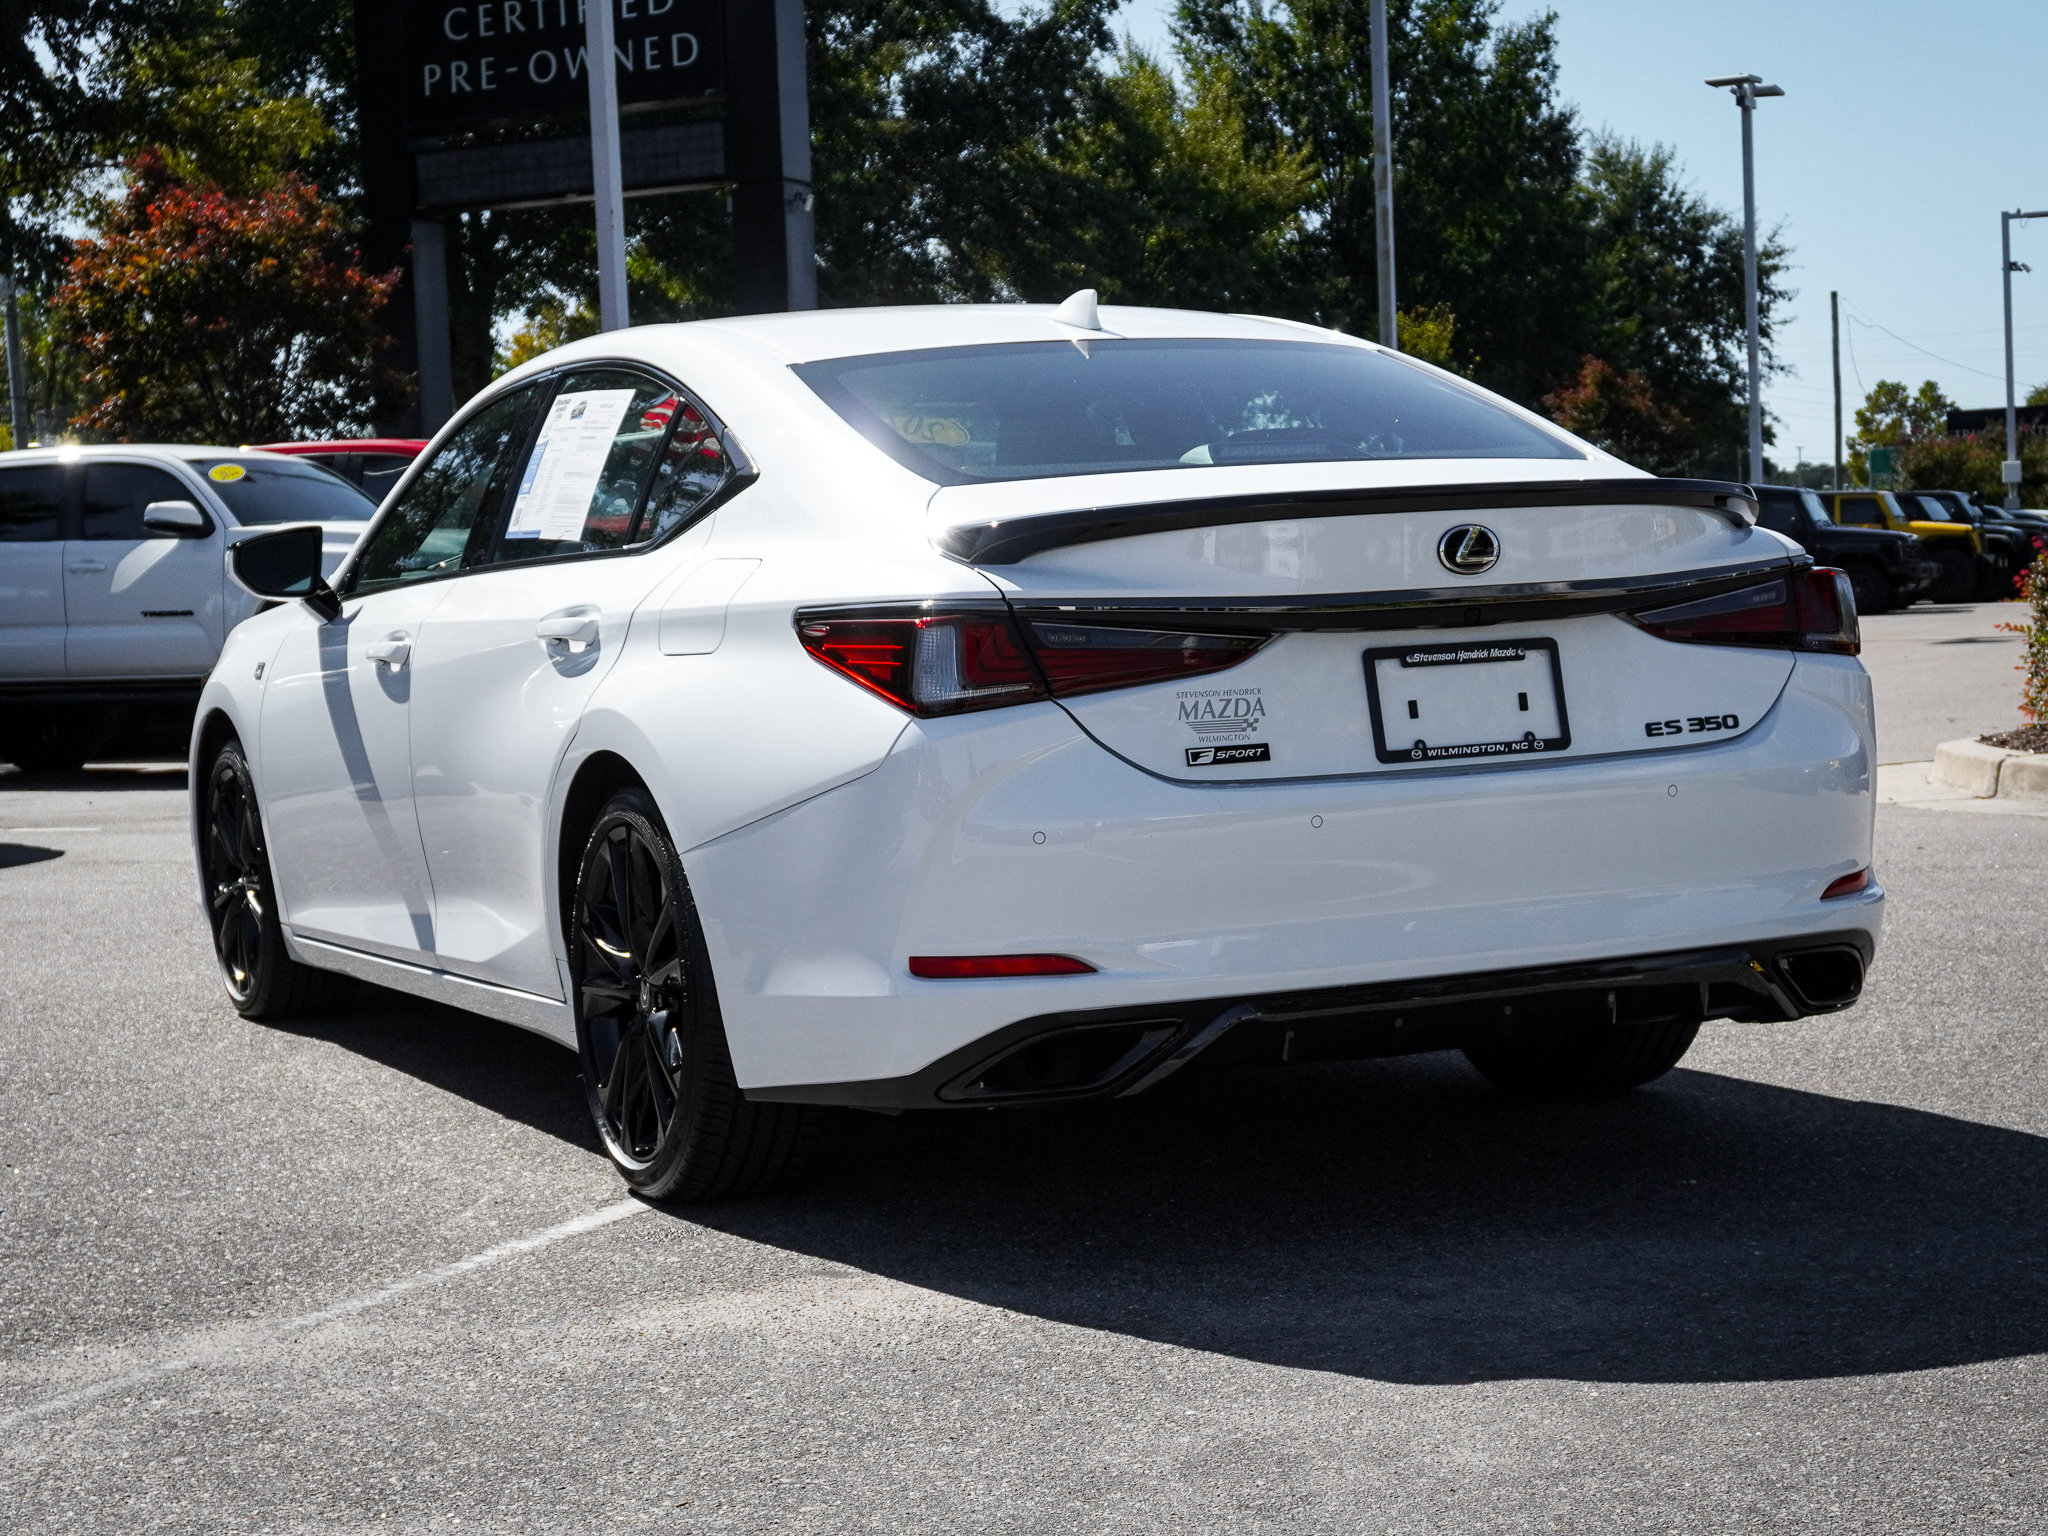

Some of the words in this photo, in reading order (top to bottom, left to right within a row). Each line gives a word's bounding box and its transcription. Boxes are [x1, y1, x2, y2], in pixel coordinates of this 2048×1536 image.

[444, 0, 674, 41] CERTIE
[423, 32, 699, 97] PRE-OWNED
[1413, 652, 1456, 662] Stevenson
[1457, 648, 1488, 661] Hendrick
[1489, 647, 1516, 657] Mazda
[1175, 689, 1220, 699] STEVENSON
[1222, 687, 1262, 697] HENDRICK
[1178, 697, 1266, 720] MAZDA
[1645, 719, 1683, 737] ES
[1687, 714, 1740, 733] 350
[1198, 733, 1250, 743] WILMINGTON
[1215, 748, 1265, 759] SPORT
[1427, 744, 1508, 757] WILMINGTON,
[1512, 742, 1529, 751] NC
